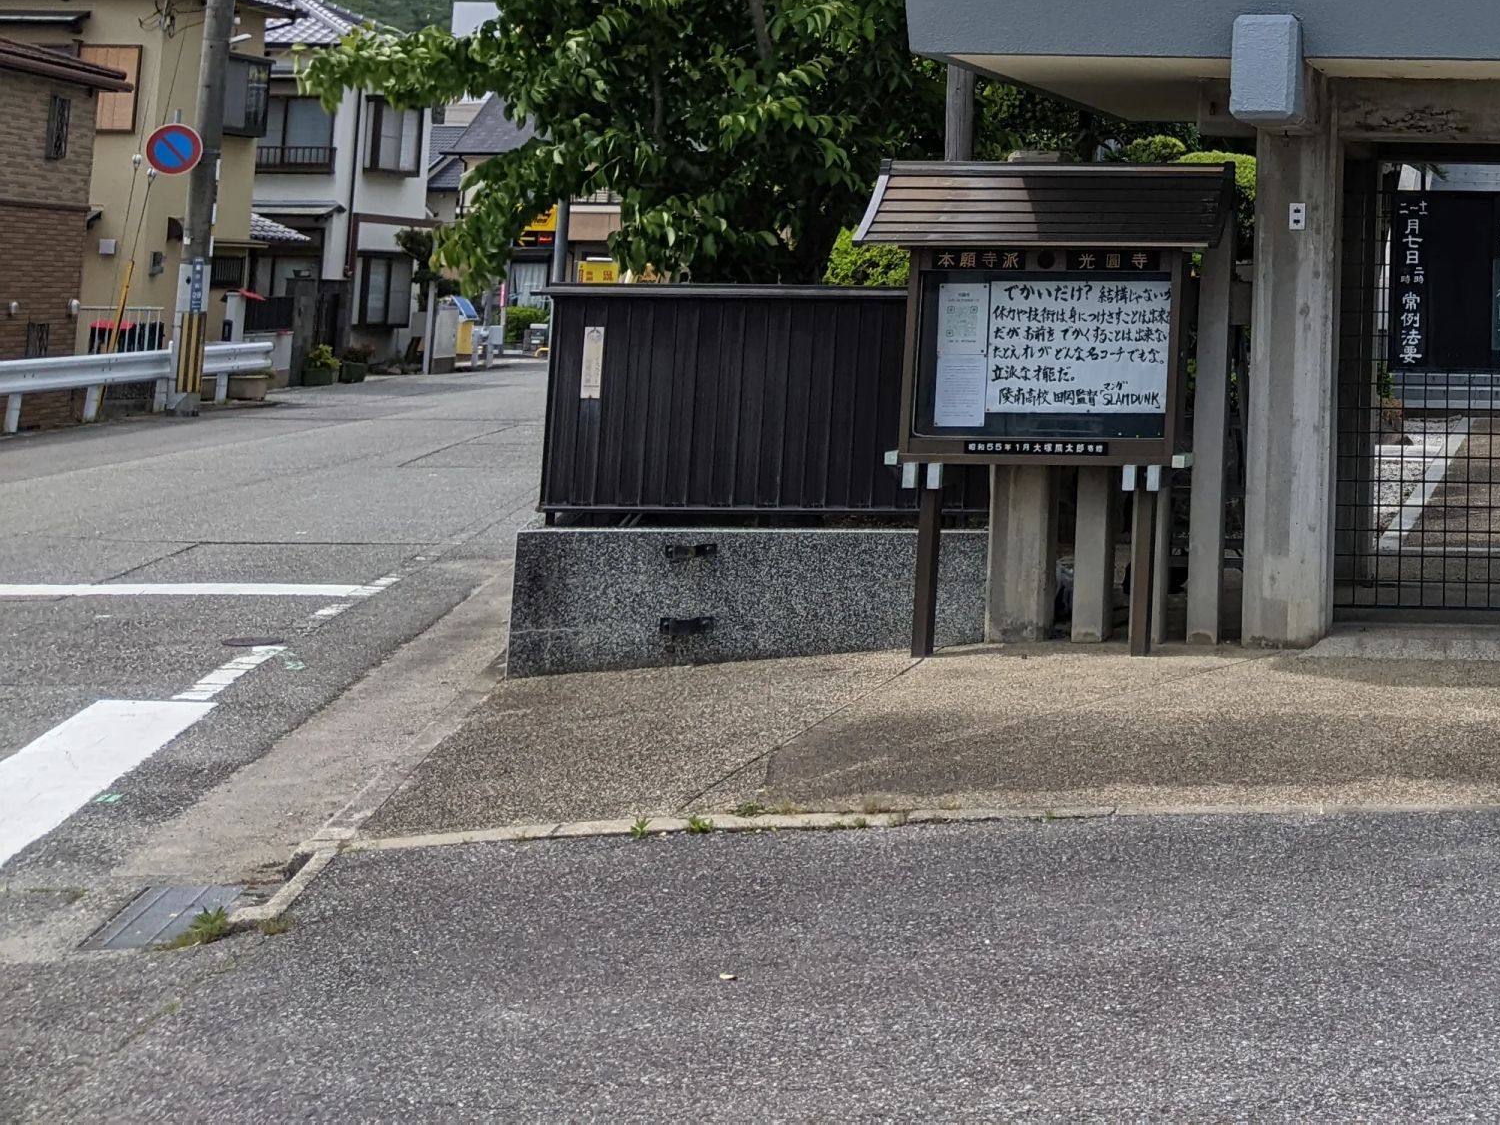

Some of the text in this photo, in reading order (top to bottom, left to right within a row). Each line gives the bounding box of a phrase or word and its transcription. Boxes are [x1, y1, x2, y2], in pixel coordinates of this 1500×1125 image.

[937, 251, 1020, 269] 本願寺派
[1078, 252, 1149, 270] 光圓寺
